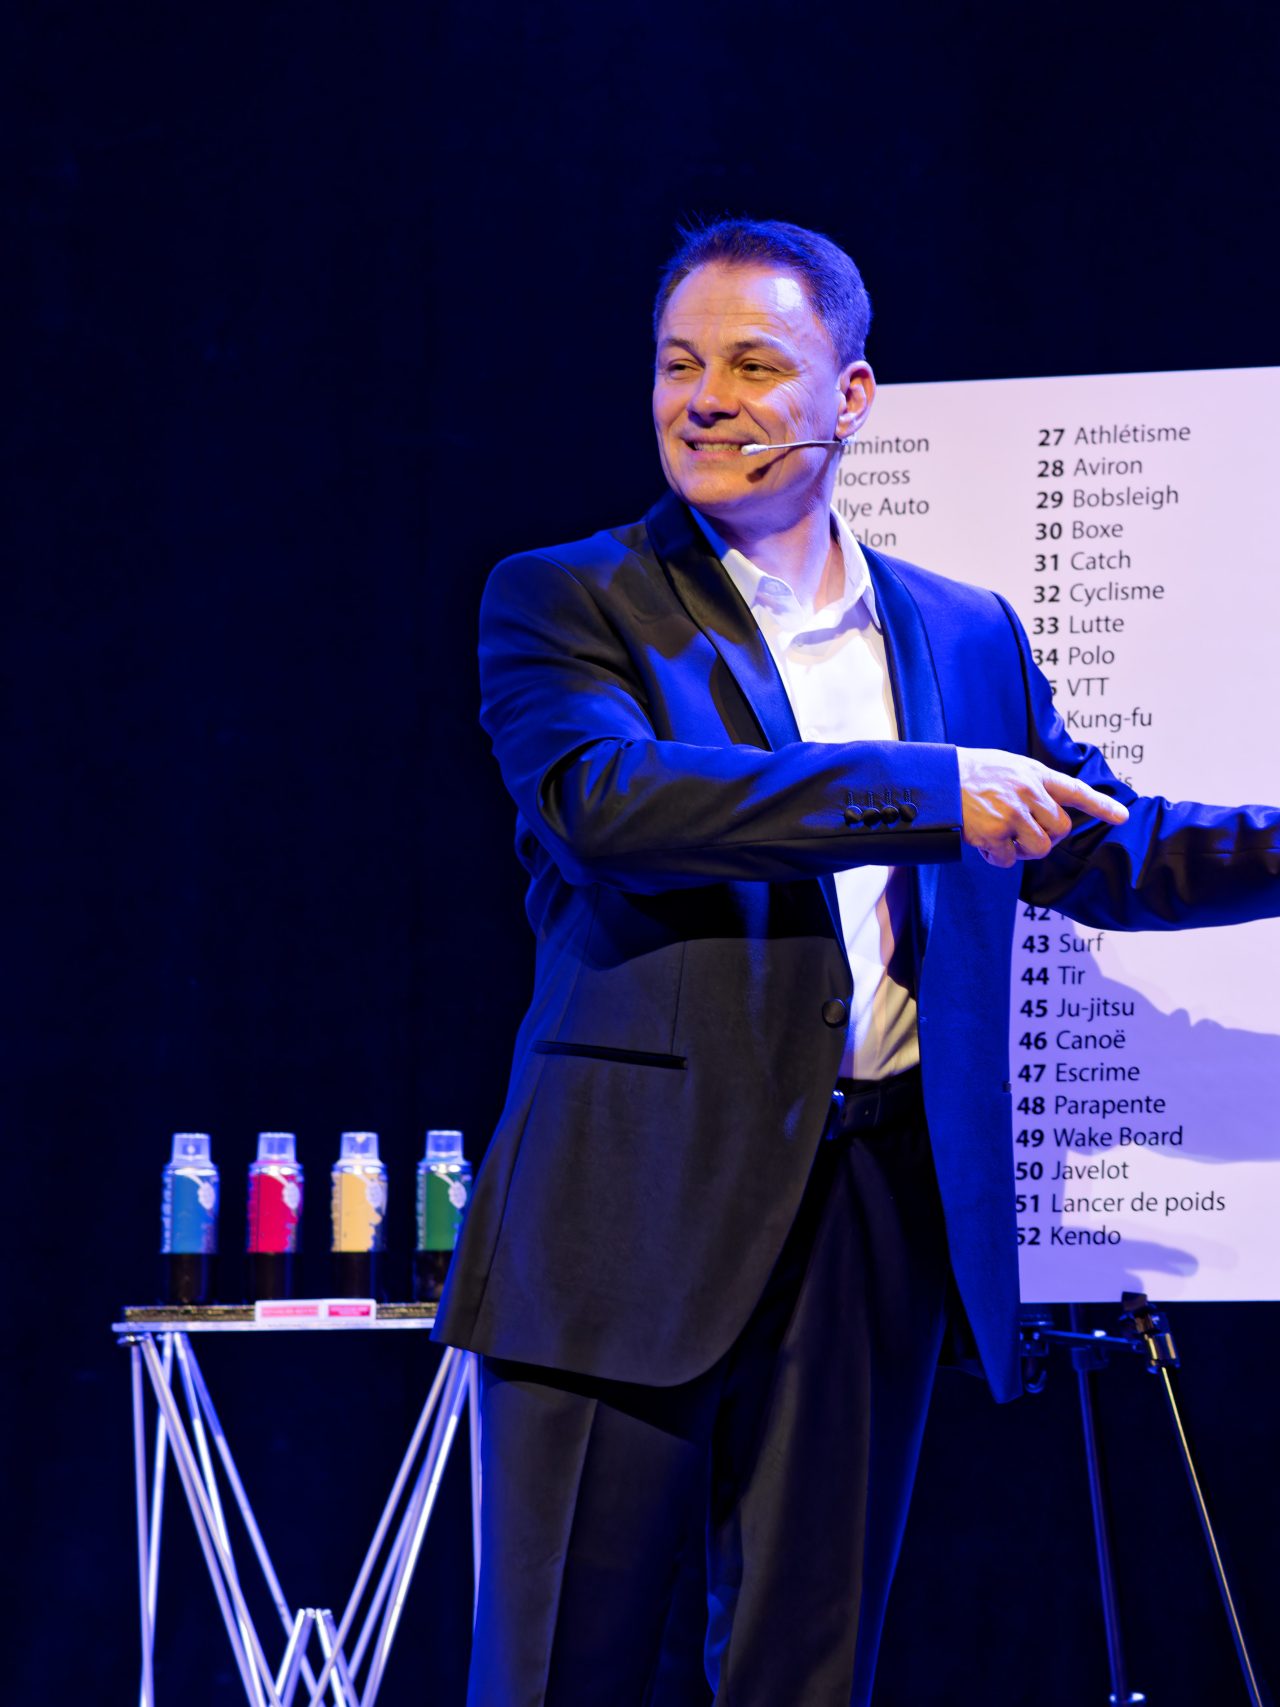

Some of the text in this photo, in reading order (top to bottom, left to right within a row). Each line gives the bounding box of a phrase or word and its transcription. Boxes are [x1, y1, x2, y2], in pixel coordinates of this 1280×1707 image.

[846, 436, 930, 455] minton
[1038, 424, 1191, 447] 27 Athlétisme
[838, 468, 911, 487] locross
[1037, 457, 1143, 478] 28 Aviron
[1036, 485, 1179, 511] 29 Bobsleigh
[836, 497, 930, 522] llye Auto
[1035, 520, 1124, 541] 30 Boxe
[1034, 549, 1131, 573] 31 Catch
[1033, 581, 1165, 607] 32 Cyclisme
[1032, 615, 1125, 636] 33 Lutte
[1033, 644, 1115, 666] 34 Polo
[1067, 677, 1110, 697] VTT
[1067, 707, 1153, 733] Kung-fu
[1102, 741, 1144, 765] ting
[1023, 904, 1051, 921] 42
[1022, 932, 1104, 954] 43 Surf
[1020, 966, 1087, 987] 44 Tir
[1019, 997, 1135, 1022] 45 Ju-jitsu
[1018, 1029, 1127, 1051] 46 Canoë
[1017, 1062, 1141, 1084] 47 Escrime
[1016, 1095, 1167, 1120] 48 Parapente
[1016, 1125, 1184, 1149] 49 Wake Board
[1015, 1160, 1129, 1181] 50 Javelot
[1015, 1191, 1226, 1217] 51 Lancer de poids
[1017, 1225, 1122, 1247] 52 Kendo
